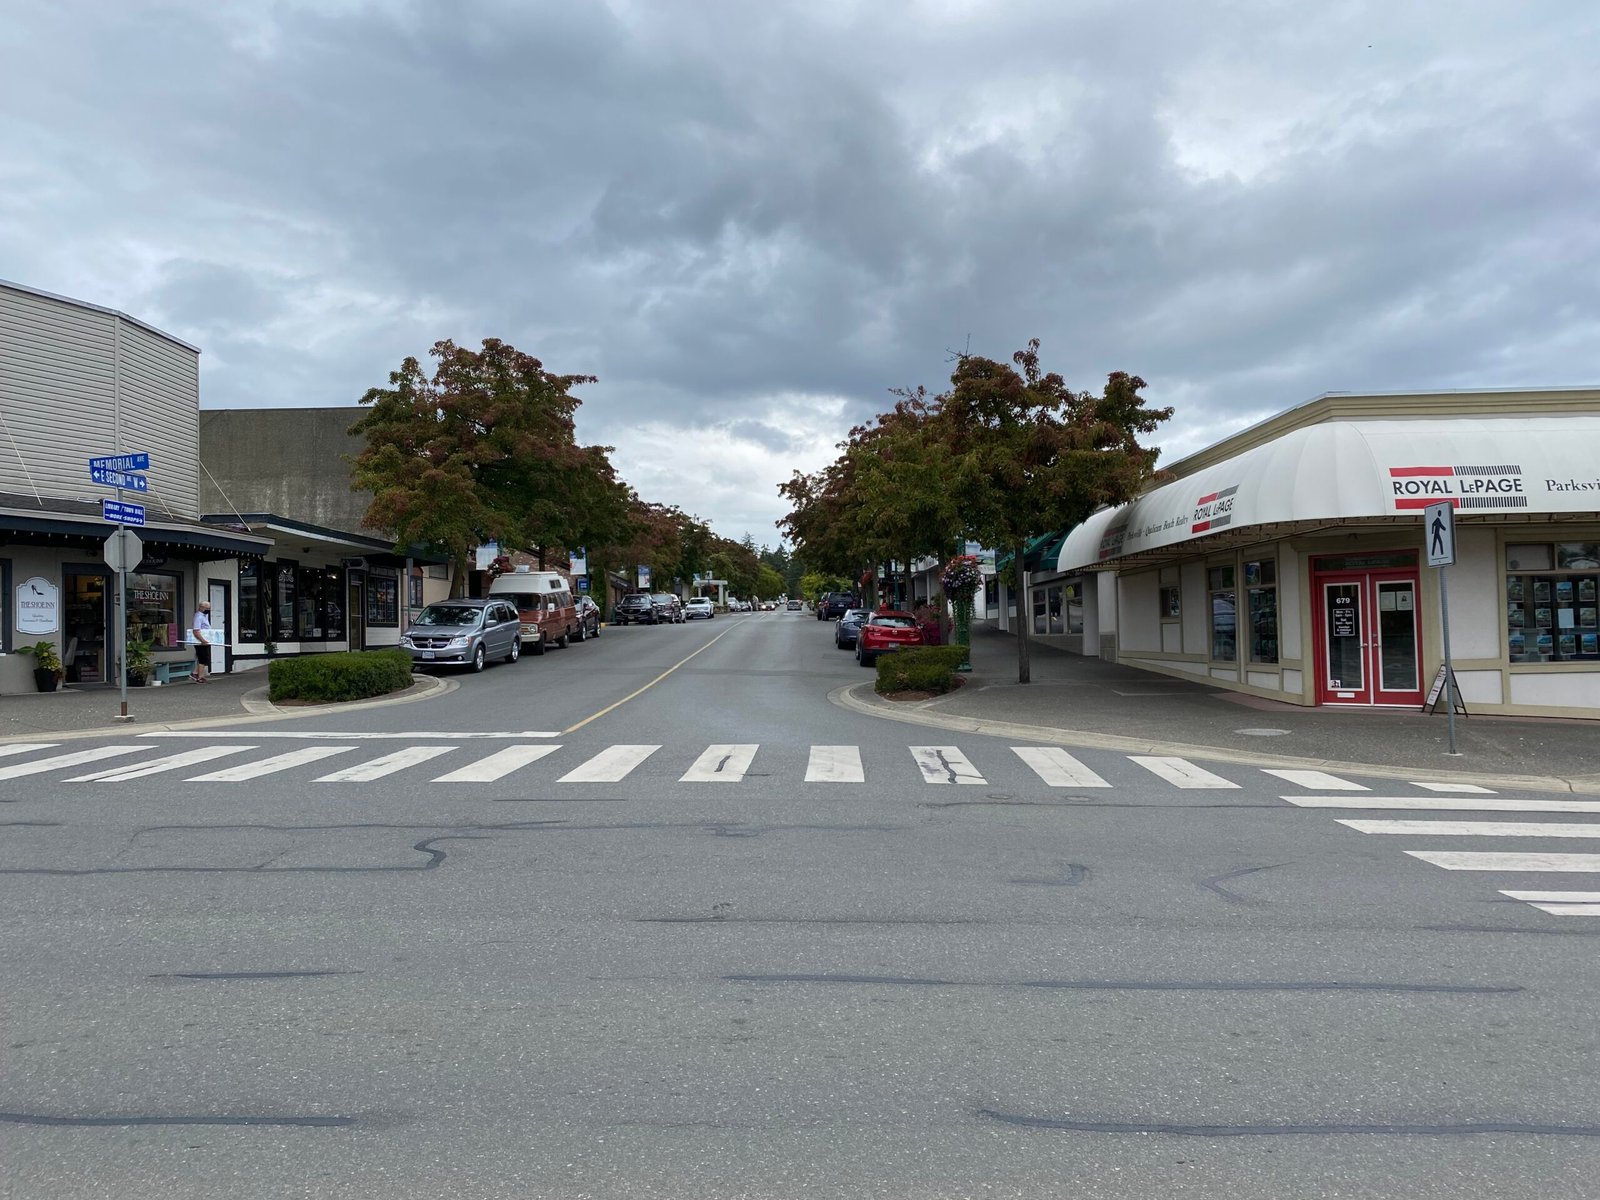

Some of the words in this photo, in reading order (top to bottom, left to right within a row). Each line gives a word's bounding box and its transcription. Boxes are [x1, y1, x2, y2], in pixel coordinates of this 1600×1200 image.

[93, 457, 135, 470] MEMORIAL
[100, 470, 104, 482] E
[105, 471, 125, 486] SECOND
[133, 477, 138, 488] W
[1392, 480, 1453, 495] ROYAL
[1163, 519, 1175, 531] Beach
[1193, 504, 1212, 521] ROYAL
